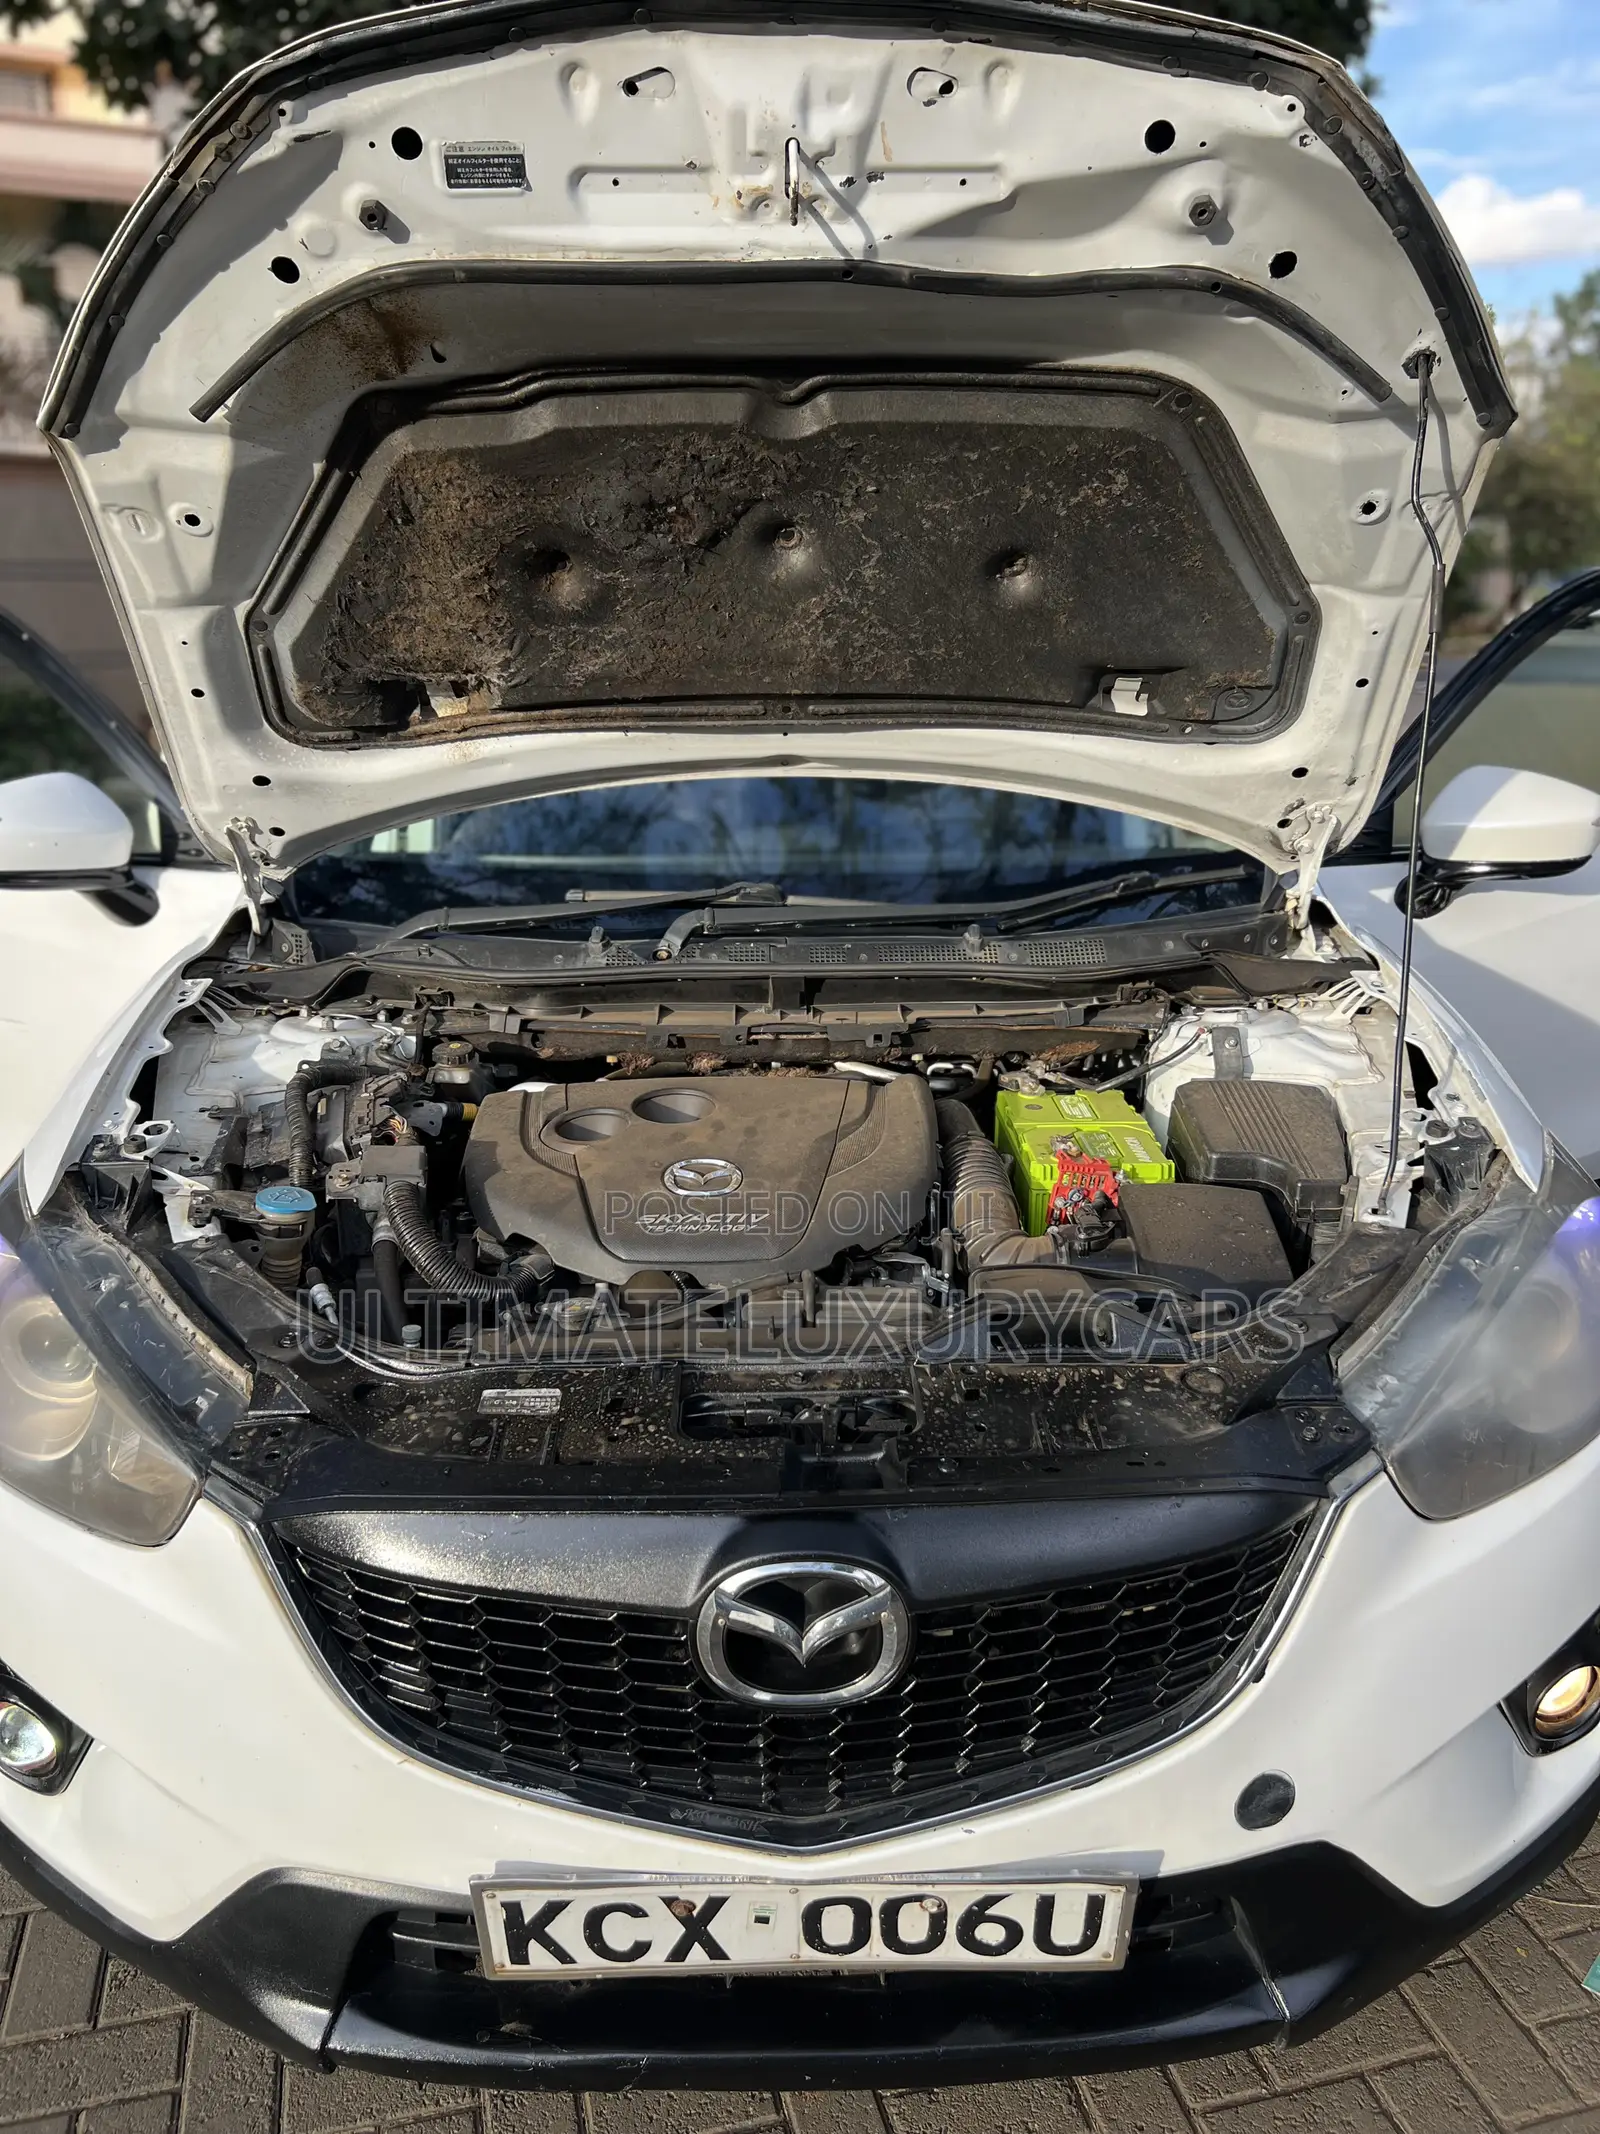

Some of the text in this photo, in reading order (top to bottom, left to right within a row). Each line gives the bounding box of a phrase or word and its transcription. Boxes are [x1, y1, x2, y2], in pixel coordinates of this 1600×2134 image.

[635, 1213, 771, 1224] SKYACTIV
[646, 1224, 758, 1232] TECHNOLOGY
[502, 1892, 1105, 1966] KCX 006U
